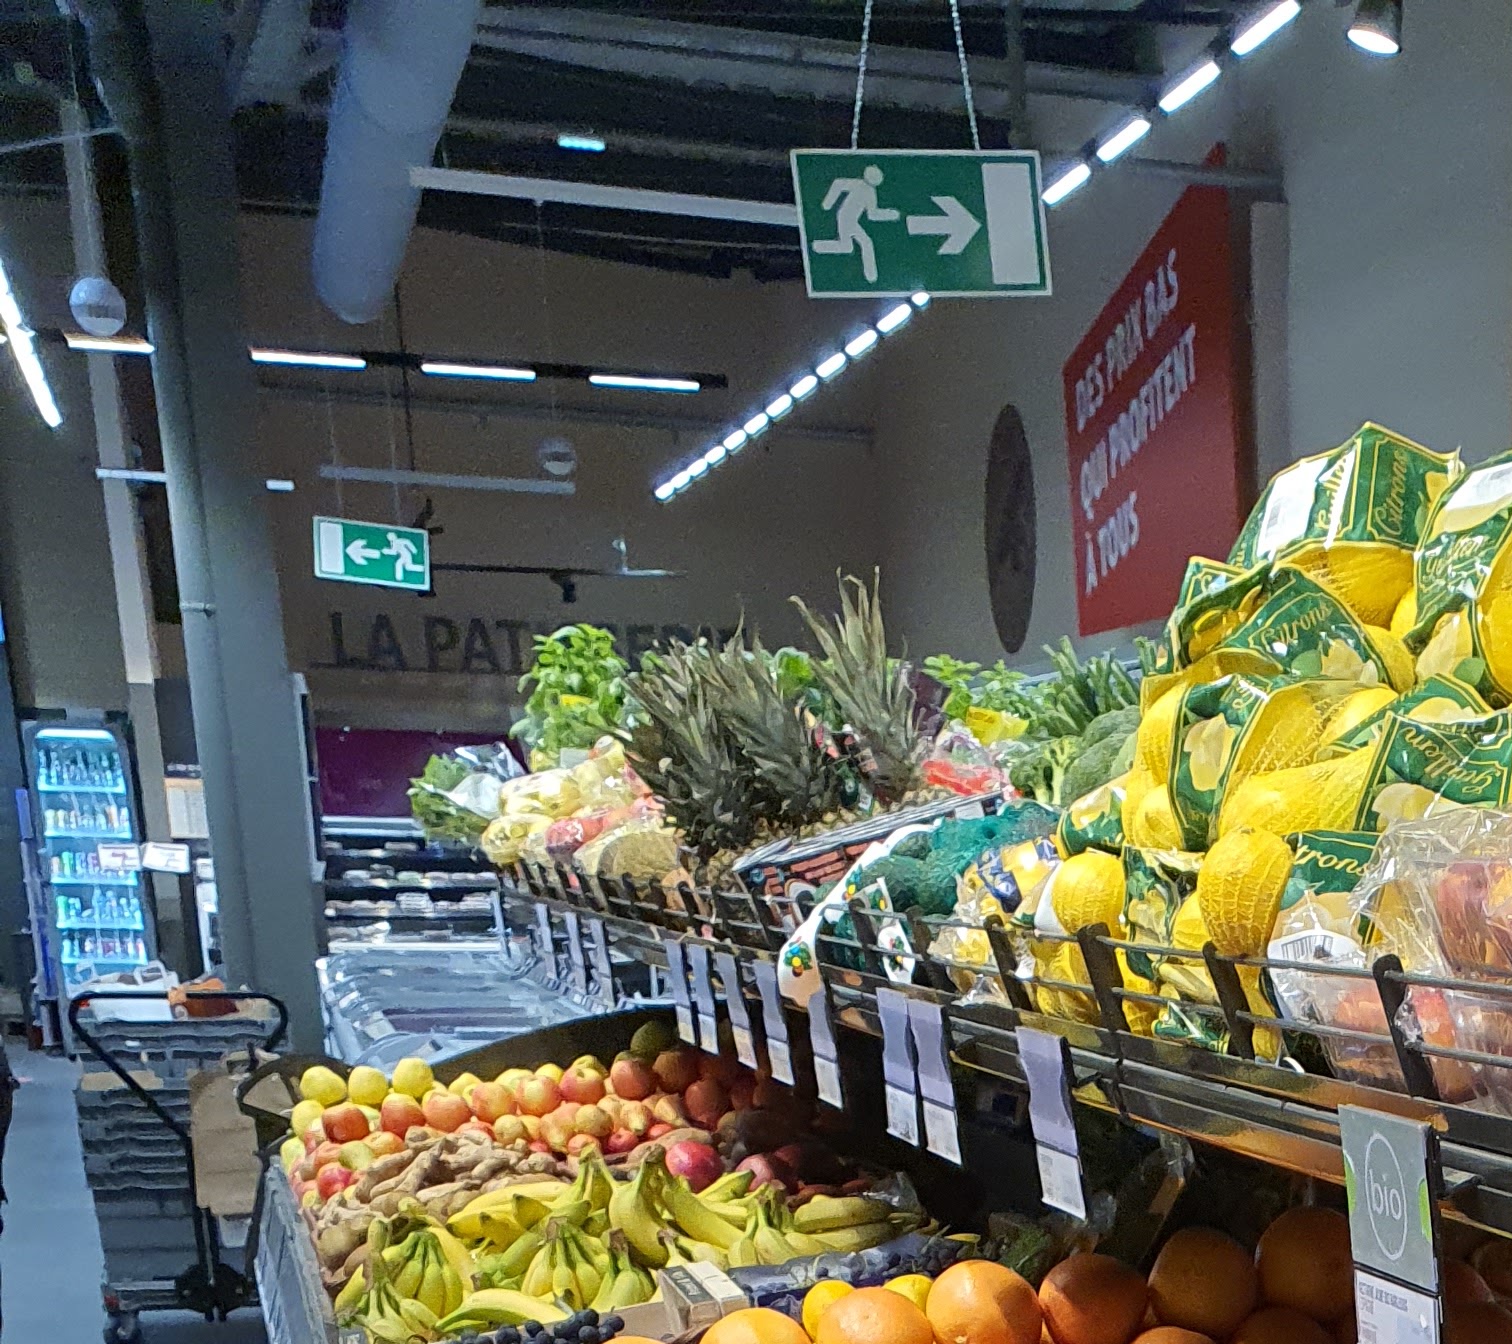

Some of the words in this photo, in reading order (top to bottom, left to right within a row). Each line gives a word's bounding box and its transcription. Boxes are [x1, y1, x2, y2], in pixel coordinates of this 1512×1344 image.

[1076, 353, 1104, 433] DES
[1145, 248, 1179, 339] BAS
[1080, 437, 1109, 522] QUI
[1108, 322, 1197, 479] PROFITENT
[1374, 450, 1409, 536] Citrons
[1097, 490, 1141, 578] TOUS
[329, 611, 407, 671] LA
[1260, 602, 1333, 653] Citrons
[1294, 844, 1370, 877] trons
[1369, 1168, 1401, 1221] bio
